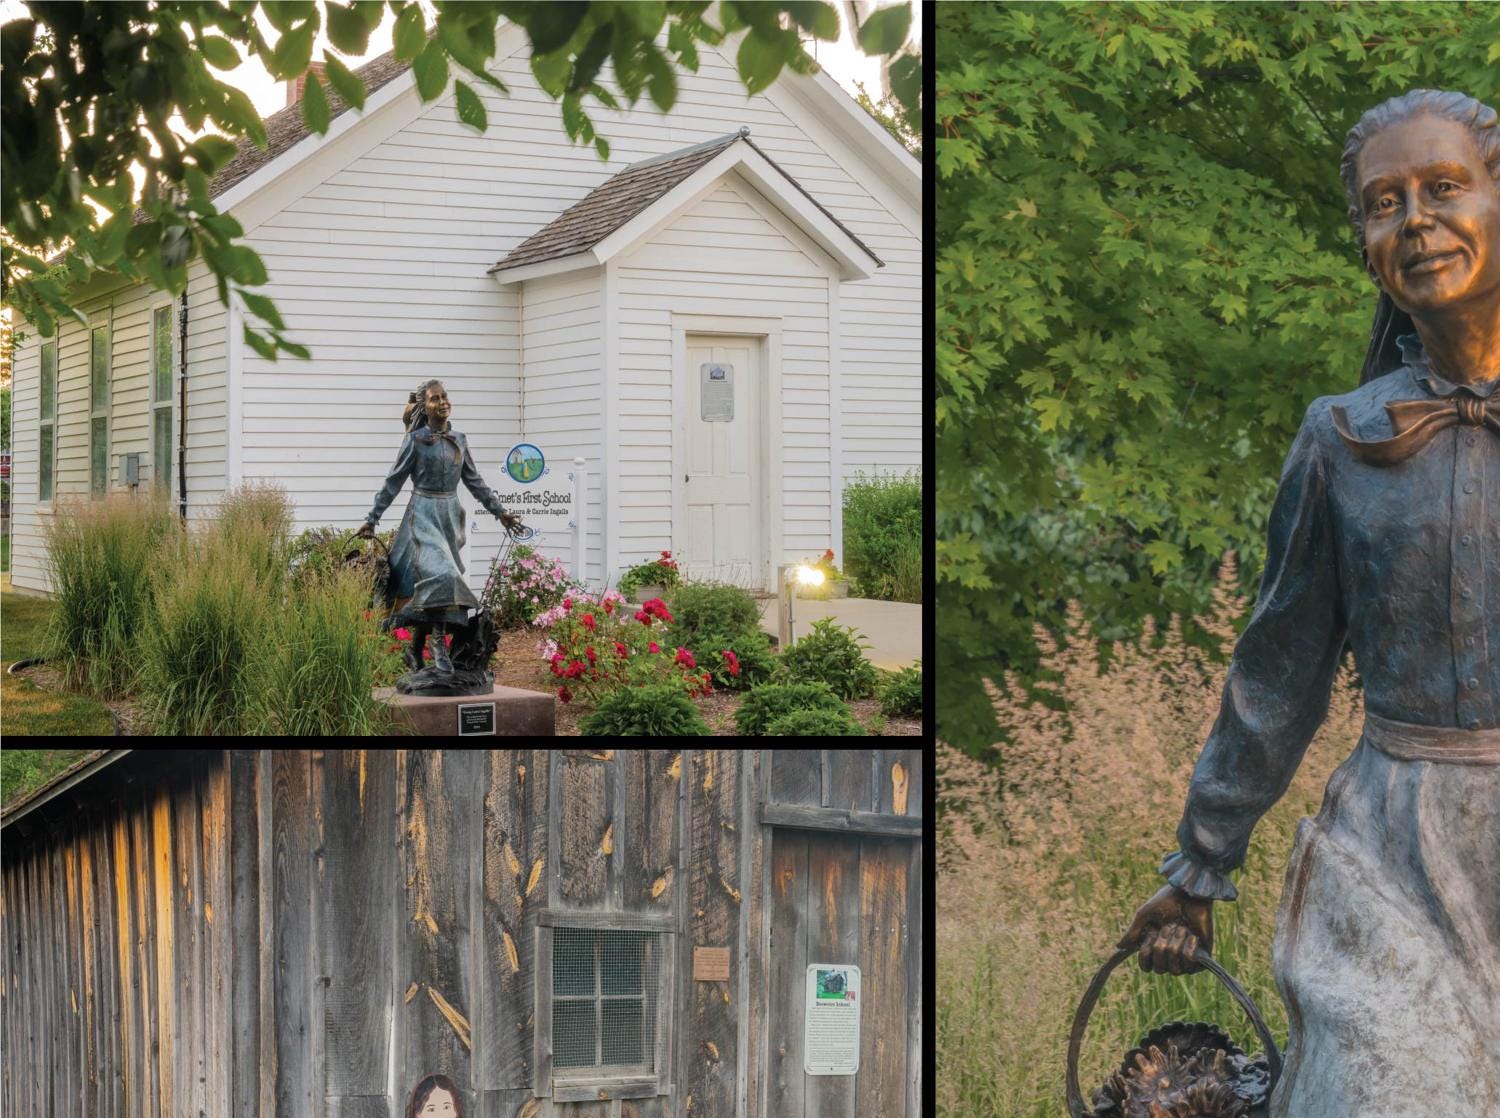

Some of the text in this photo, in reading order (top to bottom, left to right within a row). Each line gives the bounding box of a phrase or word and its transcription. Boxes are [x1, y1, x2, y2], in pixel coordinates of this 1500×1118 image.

[522, 491, 543, 504] First
[543, 490, 571, 507] School
[550, 508, 569, 516] Ingalls
